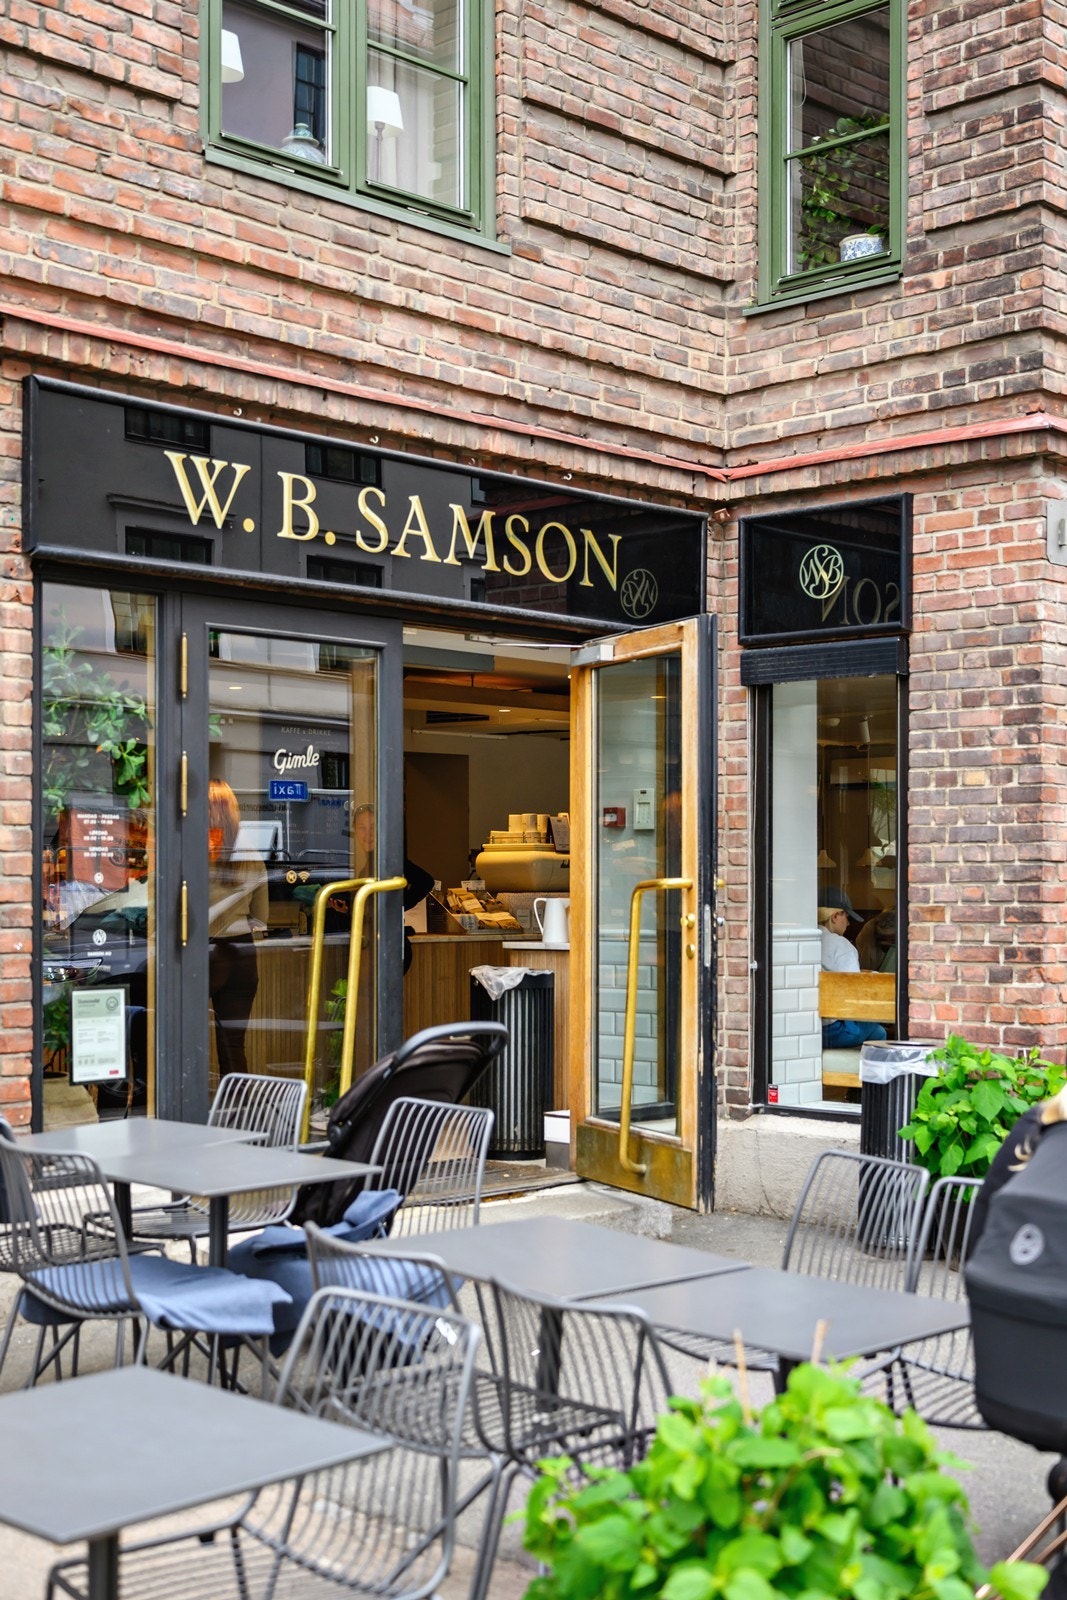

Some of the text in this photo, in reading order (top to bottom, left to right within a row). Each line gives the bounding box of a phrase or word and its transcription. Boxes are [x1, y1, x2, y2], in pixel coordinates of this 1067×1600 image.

[163, 450, 623, 590] W. B. SAMSON
[281, 727, 301, 735] KAFFE
[308, 729, 332, 737] DRIKKE
[273, 744, 320, 775] Gimle
